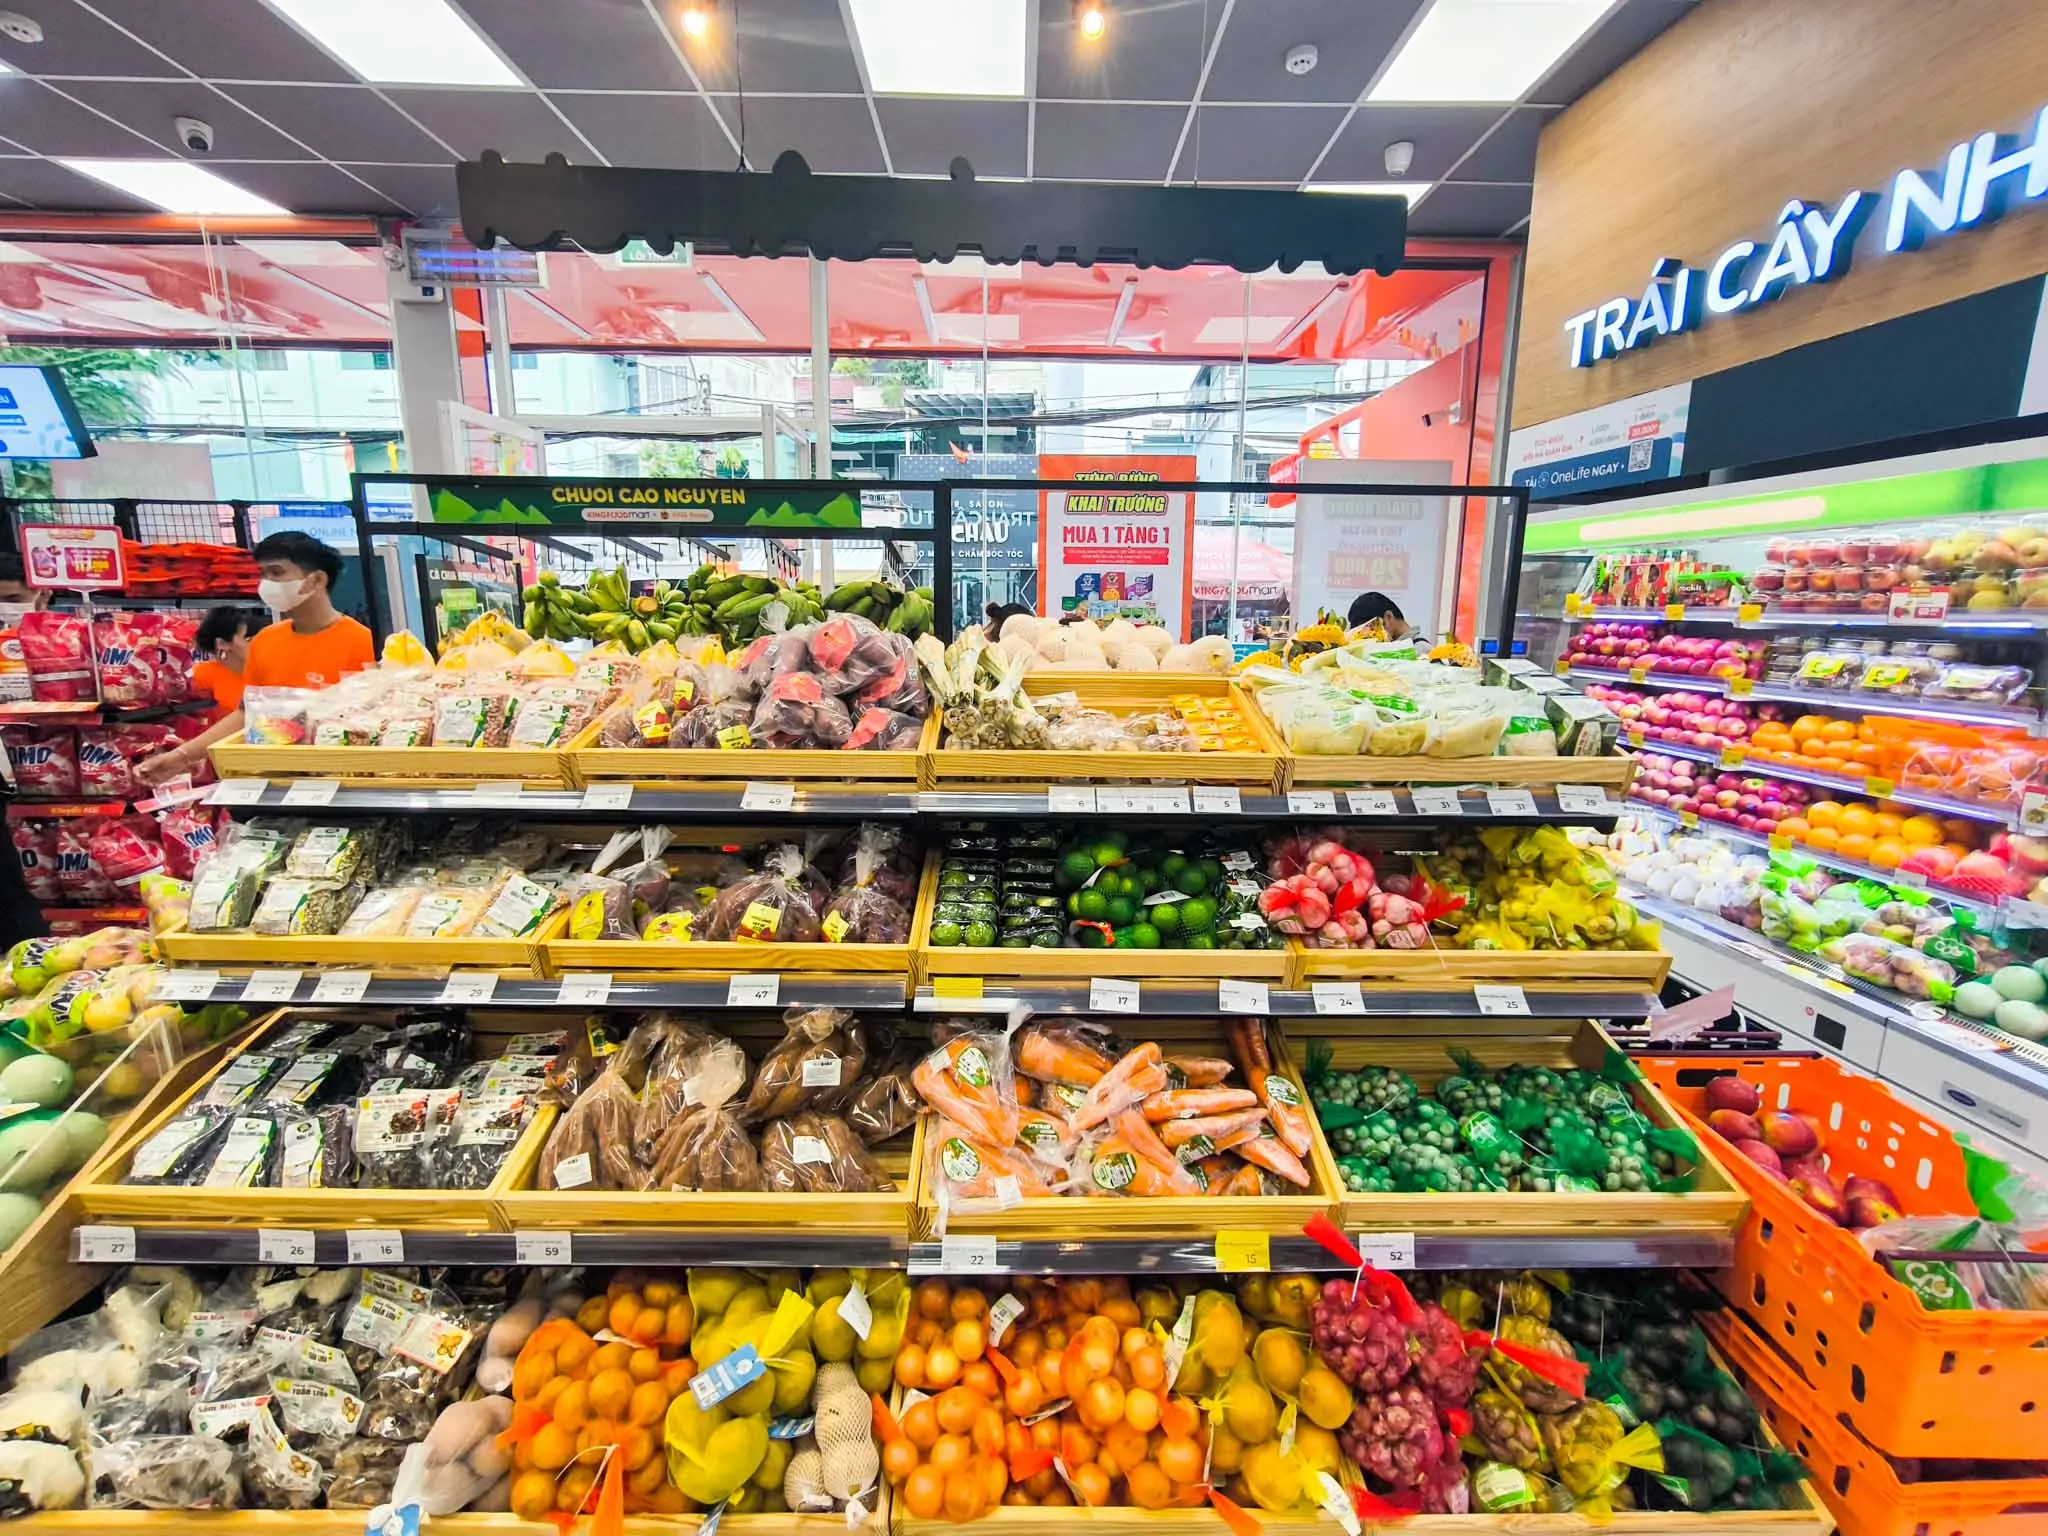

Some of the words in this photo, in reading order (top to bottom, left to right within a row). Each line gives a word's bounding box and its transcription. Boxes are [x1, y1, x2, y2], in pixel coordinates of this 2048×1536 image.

[1564, 257, 1689, 368] TRÁI
[1706, 191, 1862, 313] CÂY
[1551, 466, 1591, 485] OneLife
[1592, 462, 1620, 477] NGAY
[619, 488, 659, 504] CAO
[664, 488, 746, 505] NGUYEN
[969, 500, 1003, 508] SAON
[1067, 495, 1104, 512] KHAI
[1063, 526, 1097, 544] MUA
[1102, 526, 1109, 544] 1
[1115, 523, 1158, 548] TẶNG
[1163, 526, 1170, 544] 1
[1007, 547, 1024, 558] TÓC
[1224, 800, 1230, 808] 5
[1313, 801, 1326, 809] 29
[1373, 802, 1386, 810] 49
[755, 990, 768, 999] 47
[1118, 996, 1128, 1005] 17
[1251, 999, 1257, 1008] 7
[1339, 998, 1353, 1007] 24
[1505, 1000, 1519, 1010] 25
[111, 1243, 125, 1254] 27
[290, 1245, 304, 1256] 26
[381, 1245, 392, 1255] 16
[545, 1246, 559, 1257] 59
[970, 1255, 984, 1265] 22
[1390, 1251, 1403, 1261] 52
